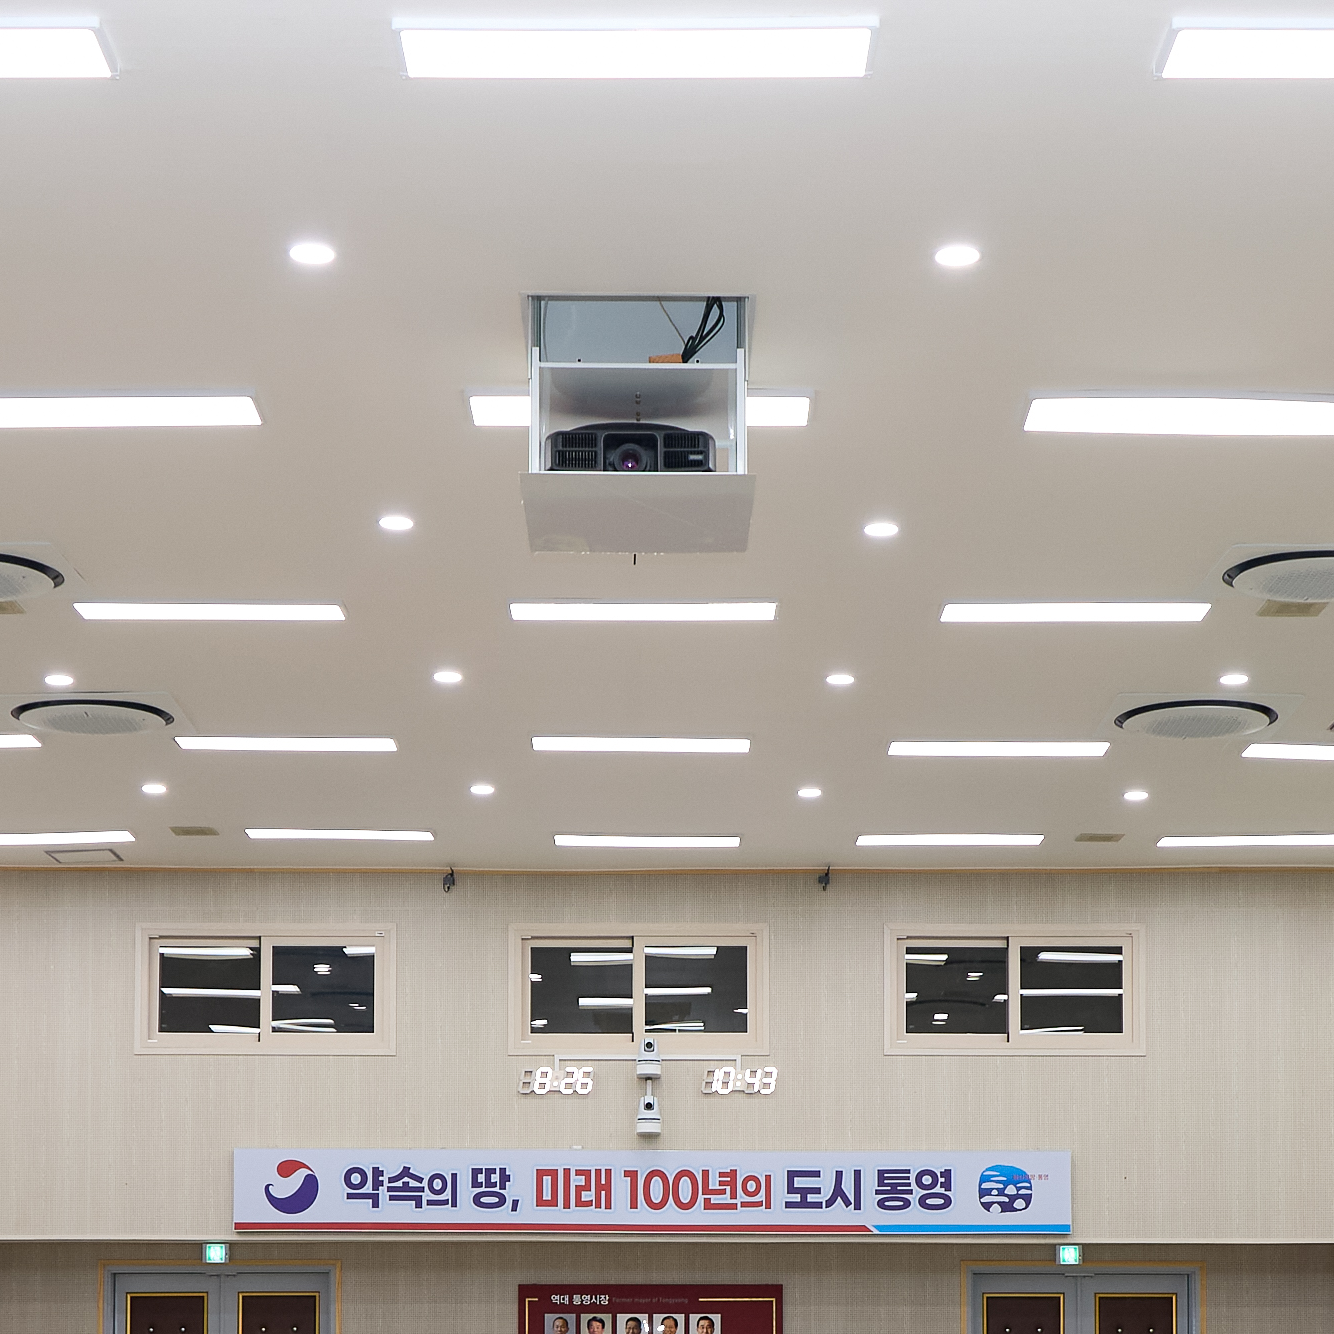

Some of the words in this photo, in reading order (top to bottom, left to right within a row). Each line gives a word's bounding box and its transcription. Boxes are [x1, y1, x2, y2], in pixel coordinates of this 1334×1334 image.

[343, 1165, 458, 1209] 약속의
[470, 1167, 520, 1213] 땅,
[535, 1167, 612, 1210] 미래
[623, 1168, 772, 1211] 100년의
[784, 1169, 862, 1211] 도시
[874, 1168, 953, 1211] 통영
[550, 1294, 569, 1305] 역대
[572, 1294, 610, 1305] 통영시장
